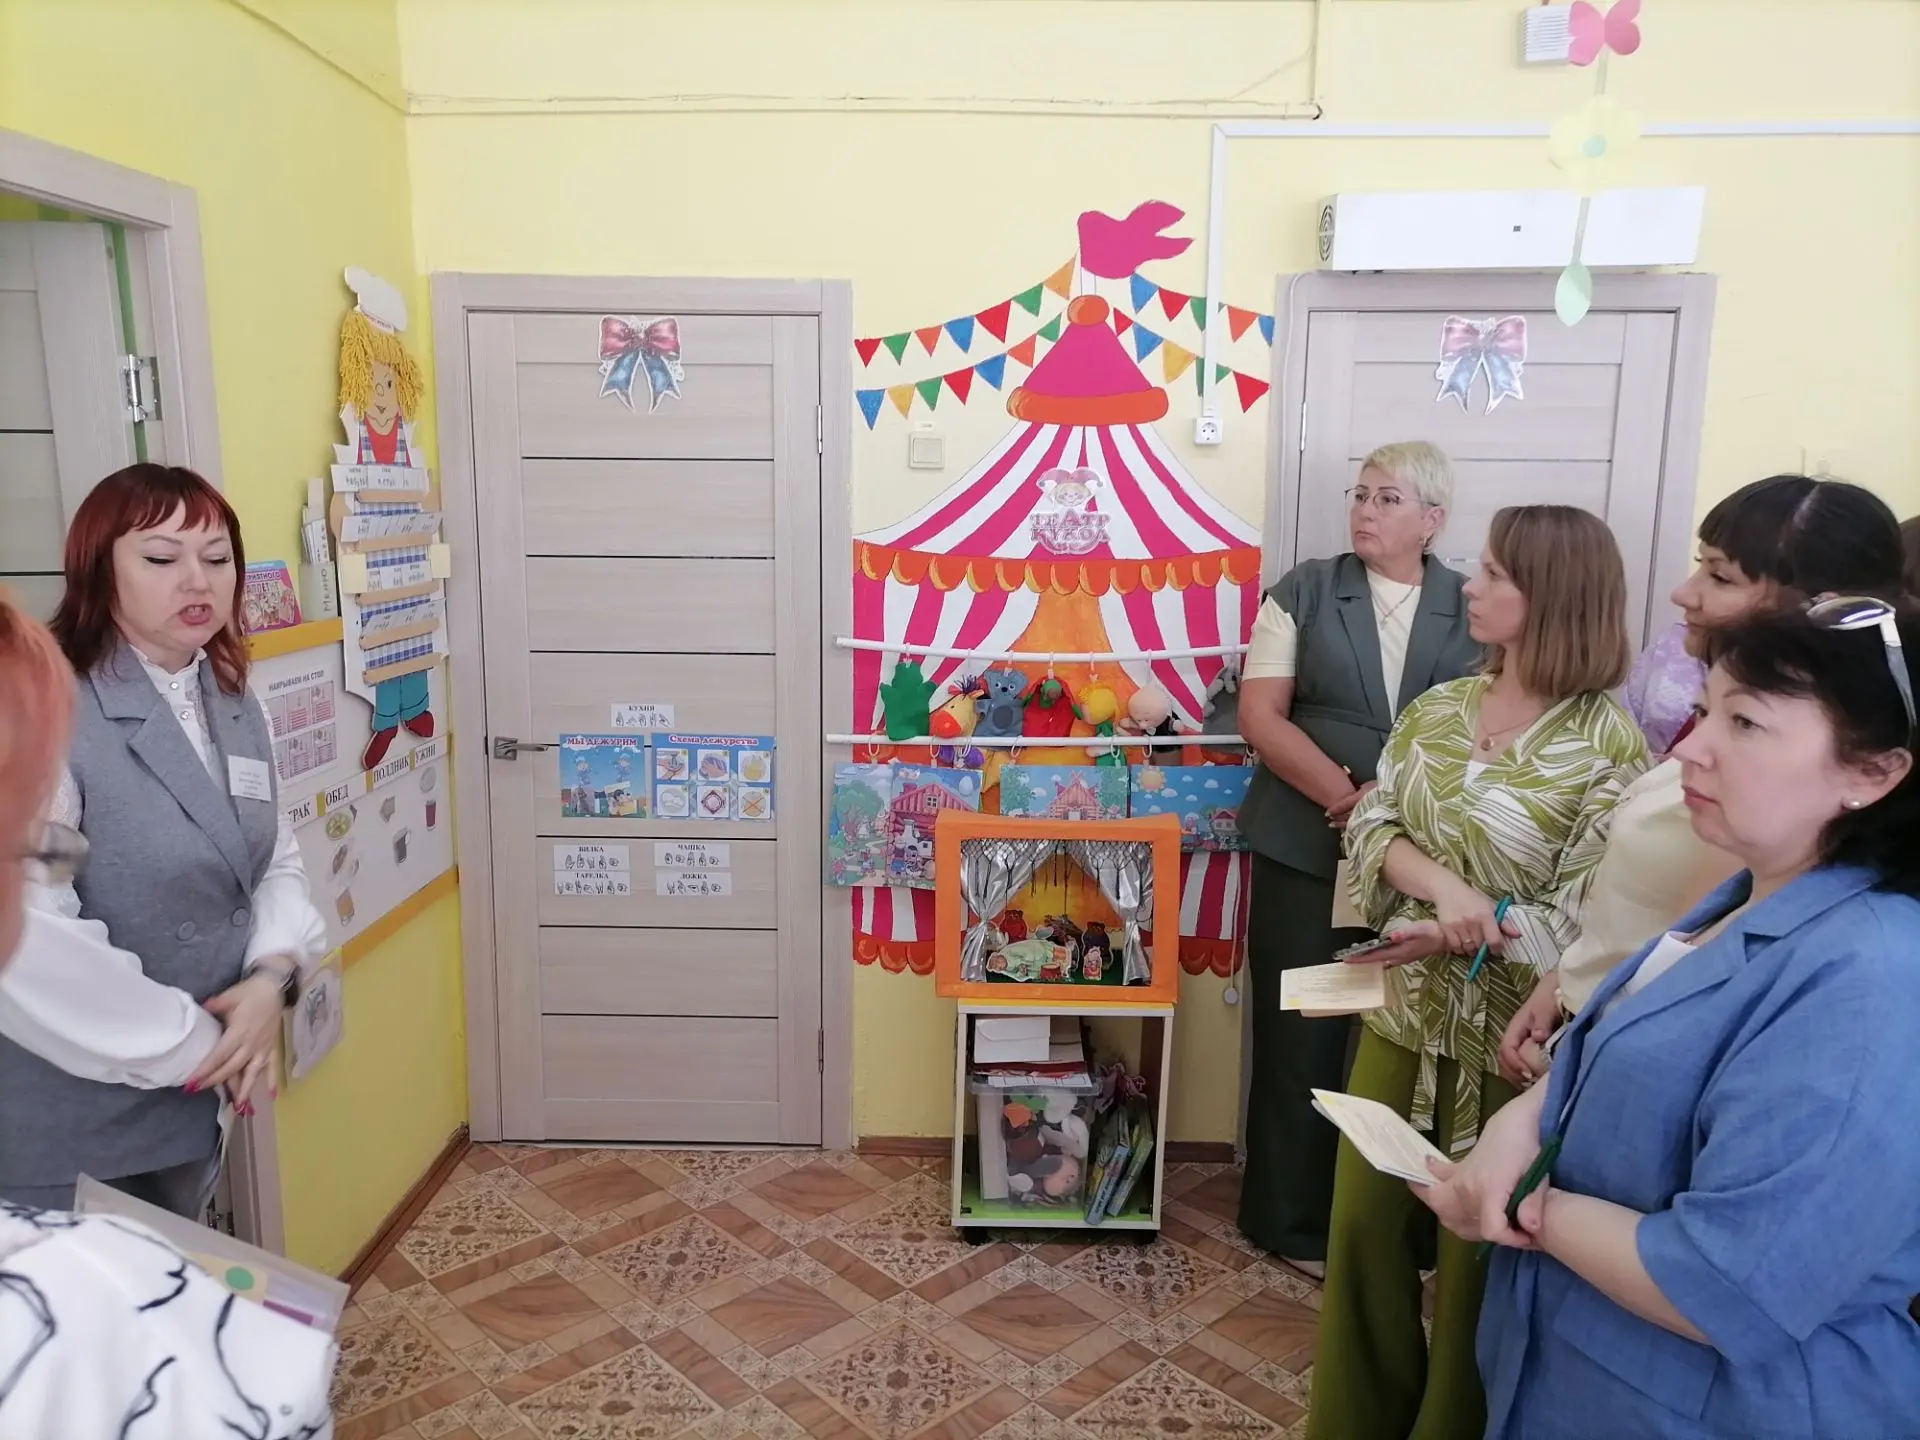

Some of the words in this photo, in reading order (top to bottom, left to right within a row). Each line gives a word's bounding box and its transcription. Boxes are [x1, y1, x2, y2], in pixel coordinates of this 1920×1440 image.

[567, 738, 586, 746] МЫ
[586, 738, 637, 746] ДЕЖУРИМ
[669, 735, 699, 744] Схема
[701, 736, 758, 746] дежурства
[415, 744, 436, 763] УЖИН
[373, 755, 409, 783] ПОЛДНИК
[325, 784, 349, 806] ОБЕД
[288, 802, 310, 822] ТРАК
